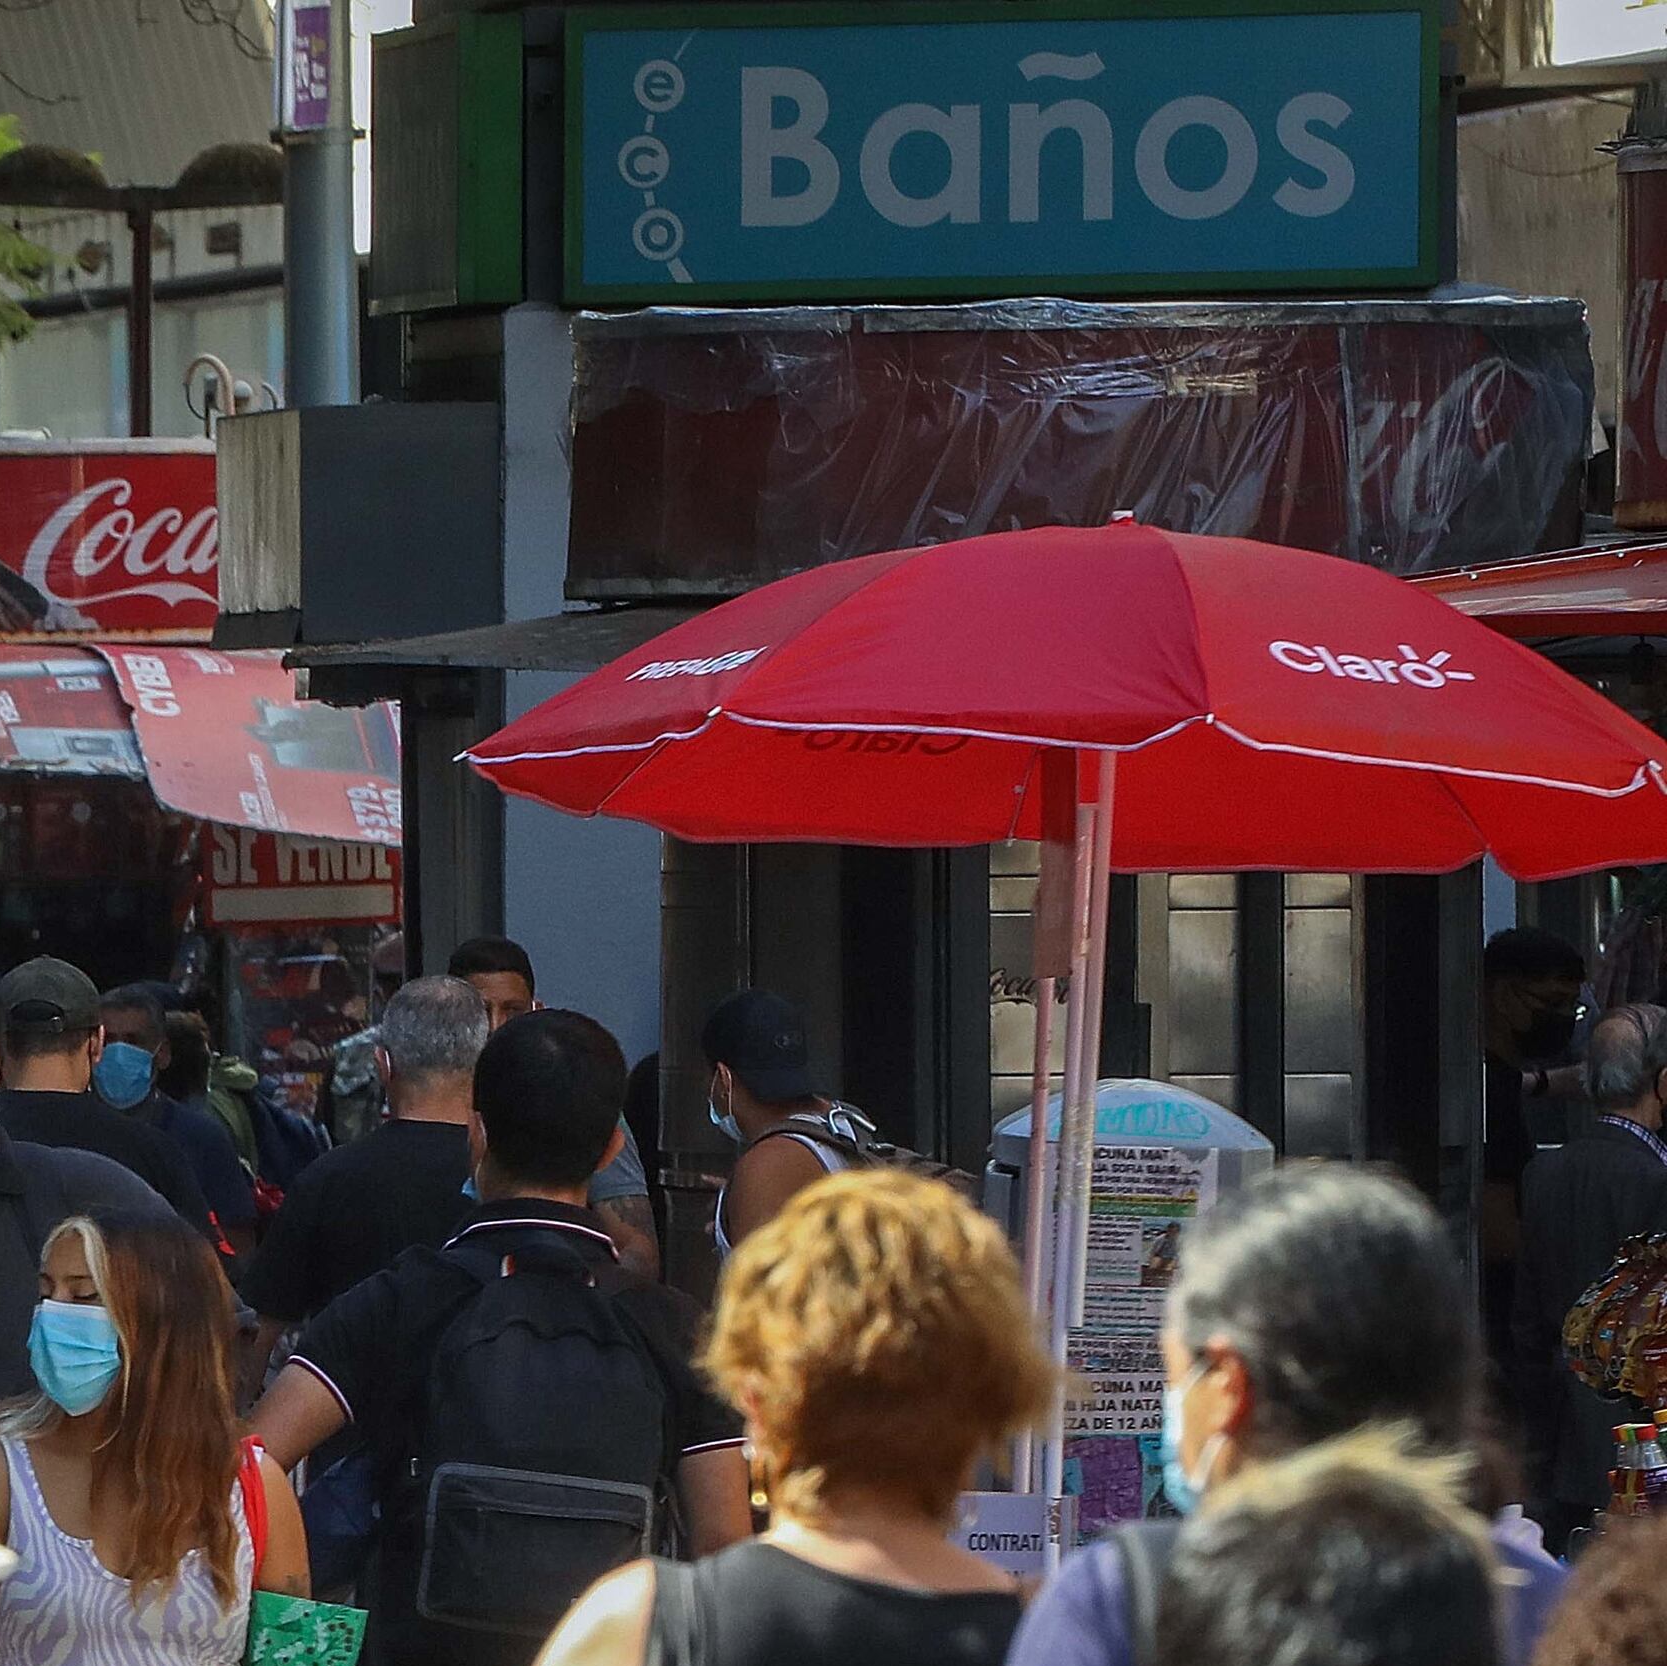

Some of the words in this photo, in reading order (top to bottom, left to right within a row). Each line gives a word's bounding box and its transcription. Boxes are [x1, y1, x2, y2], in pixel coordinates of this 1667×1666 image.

[740, 51, 1357, 228] Baños
[21, 477, 219, 607] Coca
[1268, 640, 1451, 689] Claro
[212, 824, 259, 885] SE
[273, 832, 392, 882] VENDE
[1090, 1381, 1135, 1394] CUNA
[1121, 1399, 1162, 1412] NATA
[1093, 1417, 1113, 1430] DE
[1118, 1417, 1136, 1430] 12
[1140, 1413, 1162, 1430] AÑ
